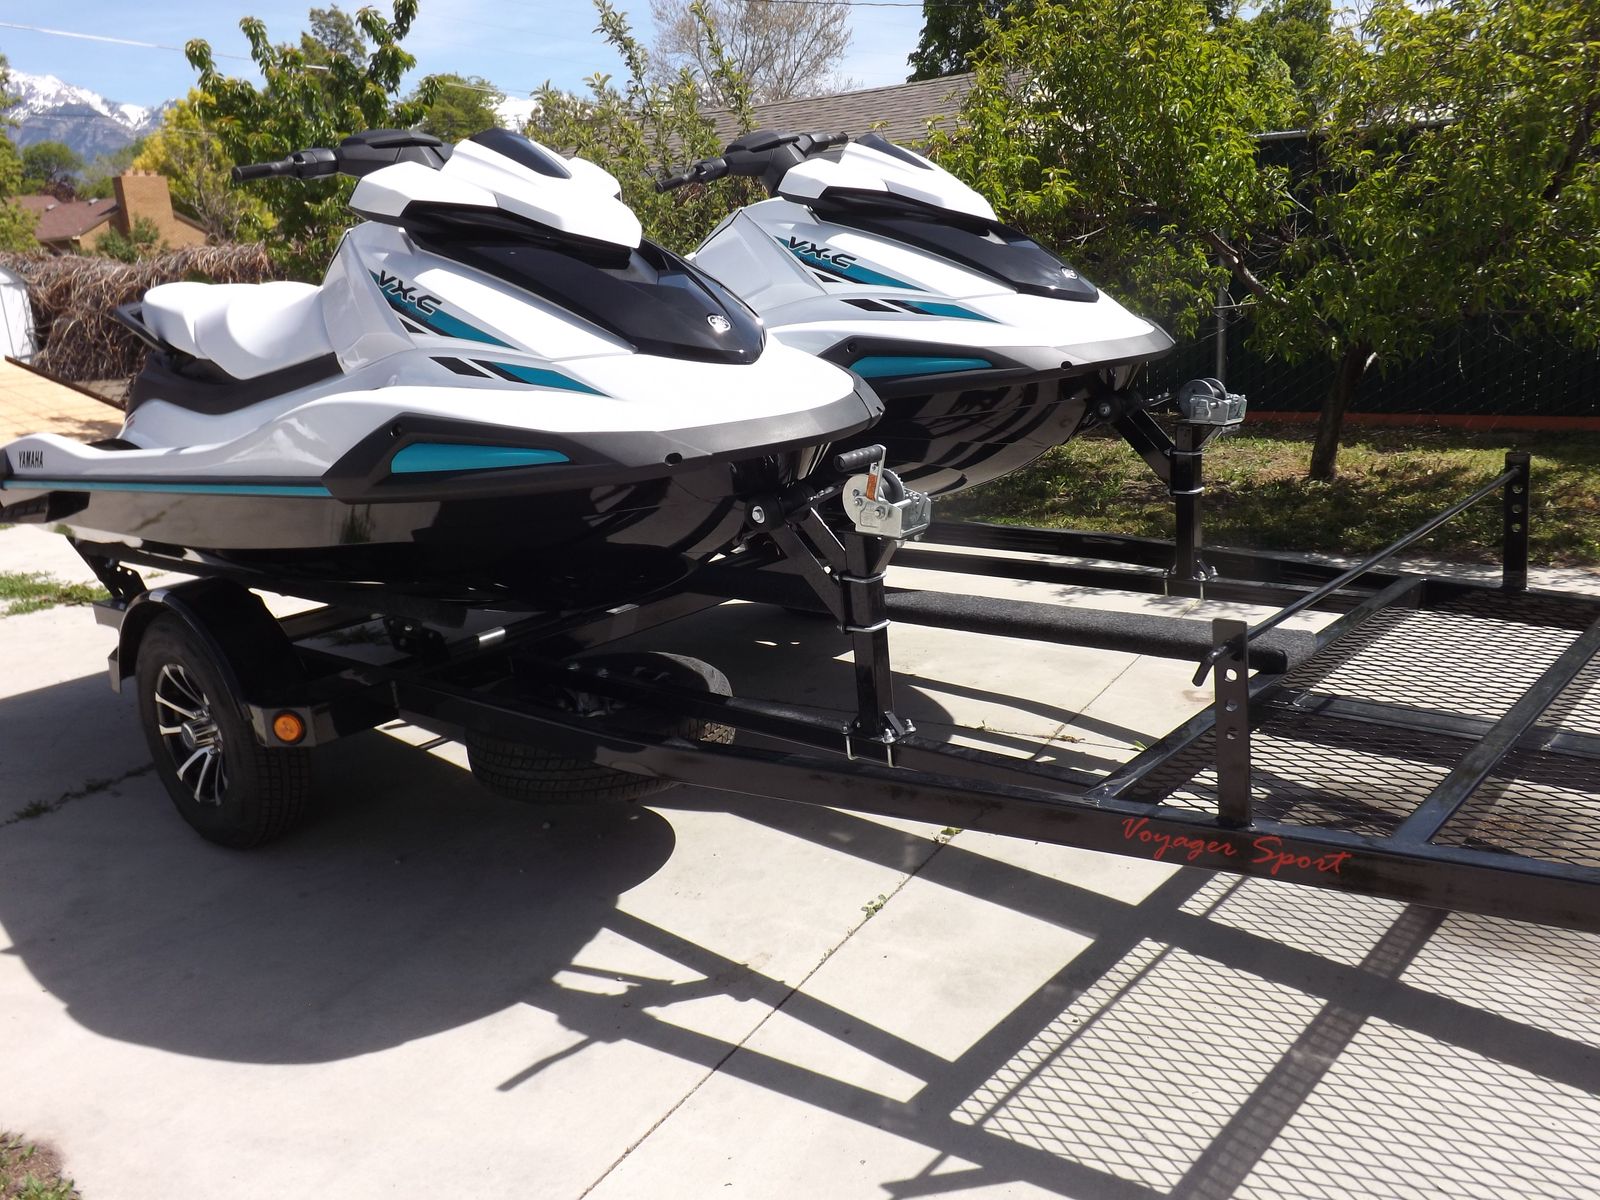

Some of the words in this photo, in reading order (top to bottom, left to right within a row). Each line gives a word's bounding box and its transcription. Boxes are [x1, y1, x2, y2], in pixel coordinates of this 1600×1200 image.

[18, 450, 44, 469] YAMAHA
[1122, 816, 1238, 861] Voyager
[1252, 835, 1352, 875] Sport
